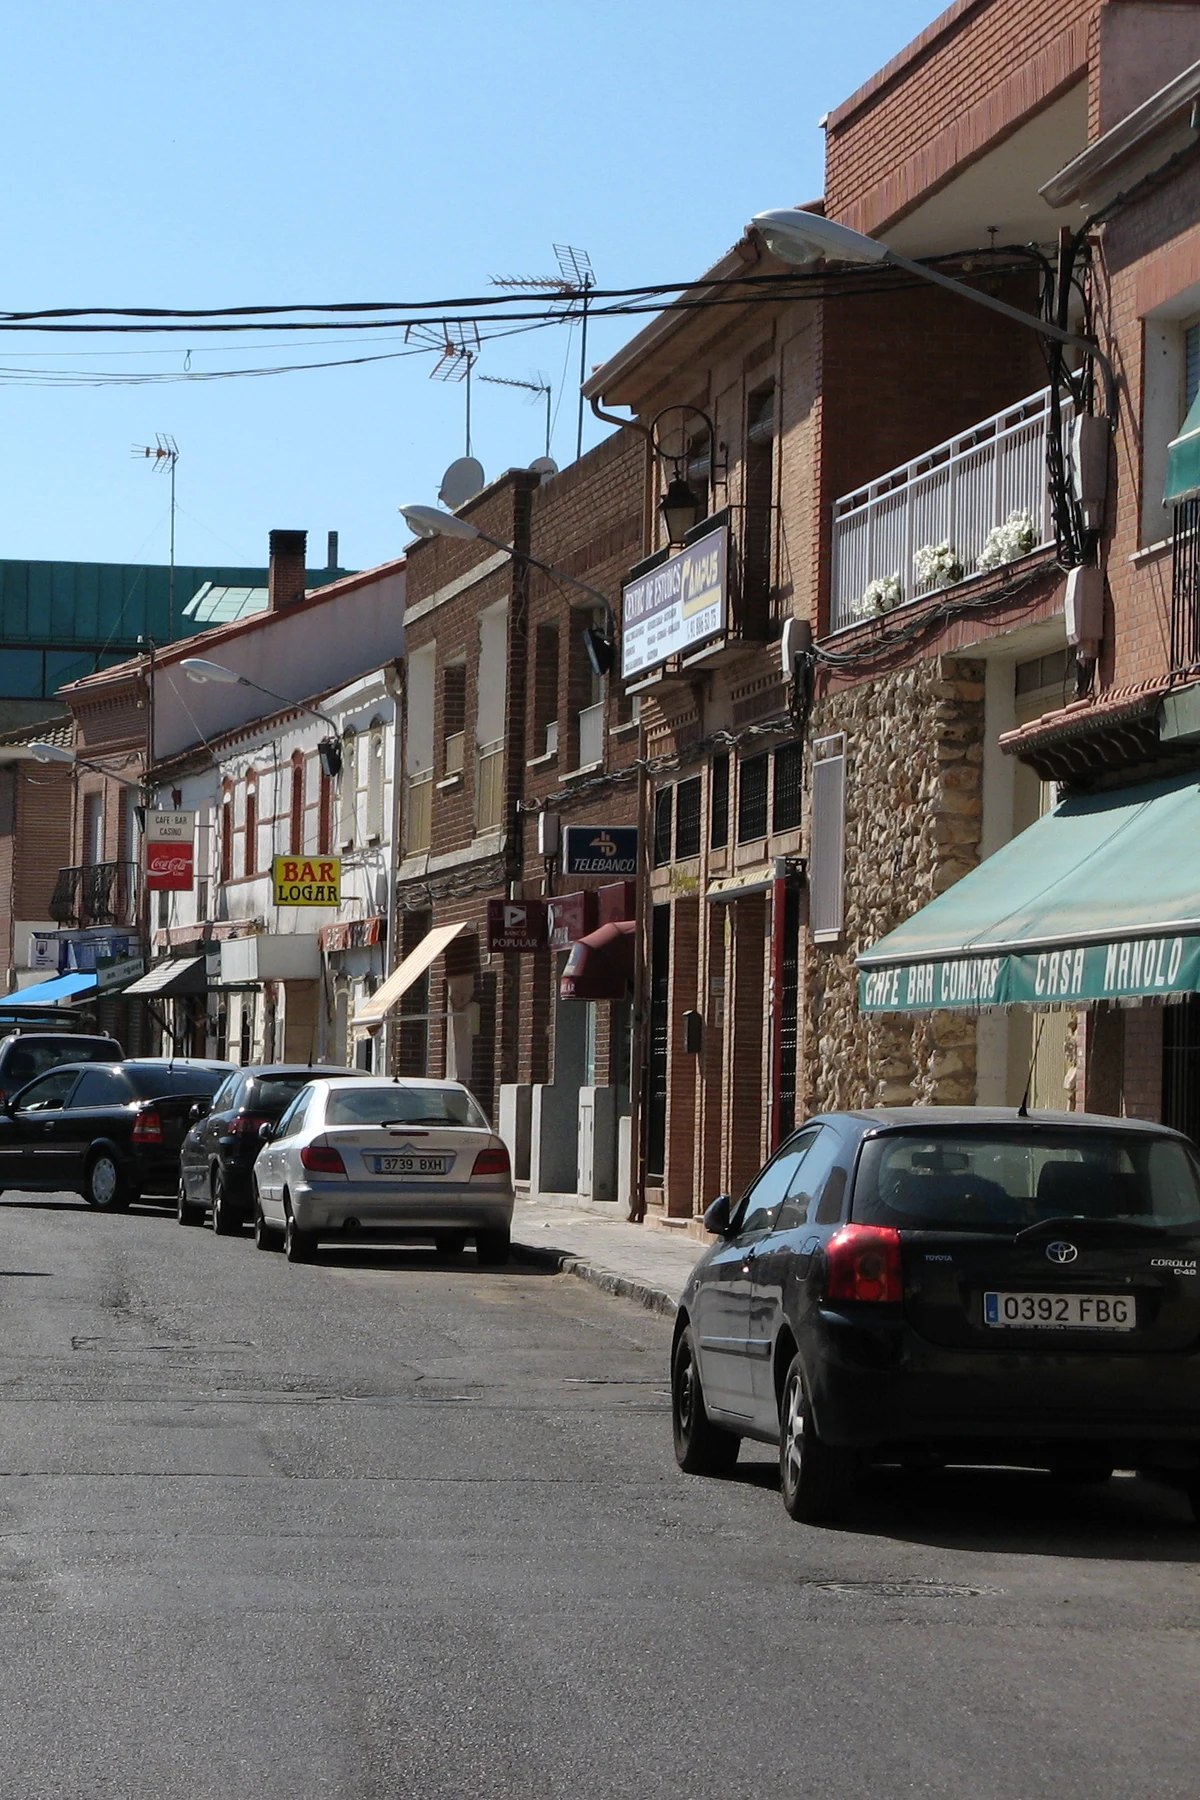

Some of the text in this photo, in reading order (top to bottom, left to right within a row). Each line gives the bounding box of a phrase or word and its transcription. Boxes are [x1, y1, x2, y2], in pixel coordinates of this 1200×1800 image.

[283, 861, 336, 882] BAR
[574, 858, 636, 872] TELEBANCO
[278, 885, 338, 902] LOGAR
[491, 938, 538, 947] POPULAR
[865, 937, 1183, 1006] CAFE BAR COMIDAS CASA MANOLO
[383, 1158, 442, 1170] 3739 BXH
[923, 1254, 953, 1262] TOYOTA
[1150, 1258, 1197, 1268] COROLLA
[1004, 1297, 1069, 1321] 0392
[1080, 1299, 1128, 1323] FBG
